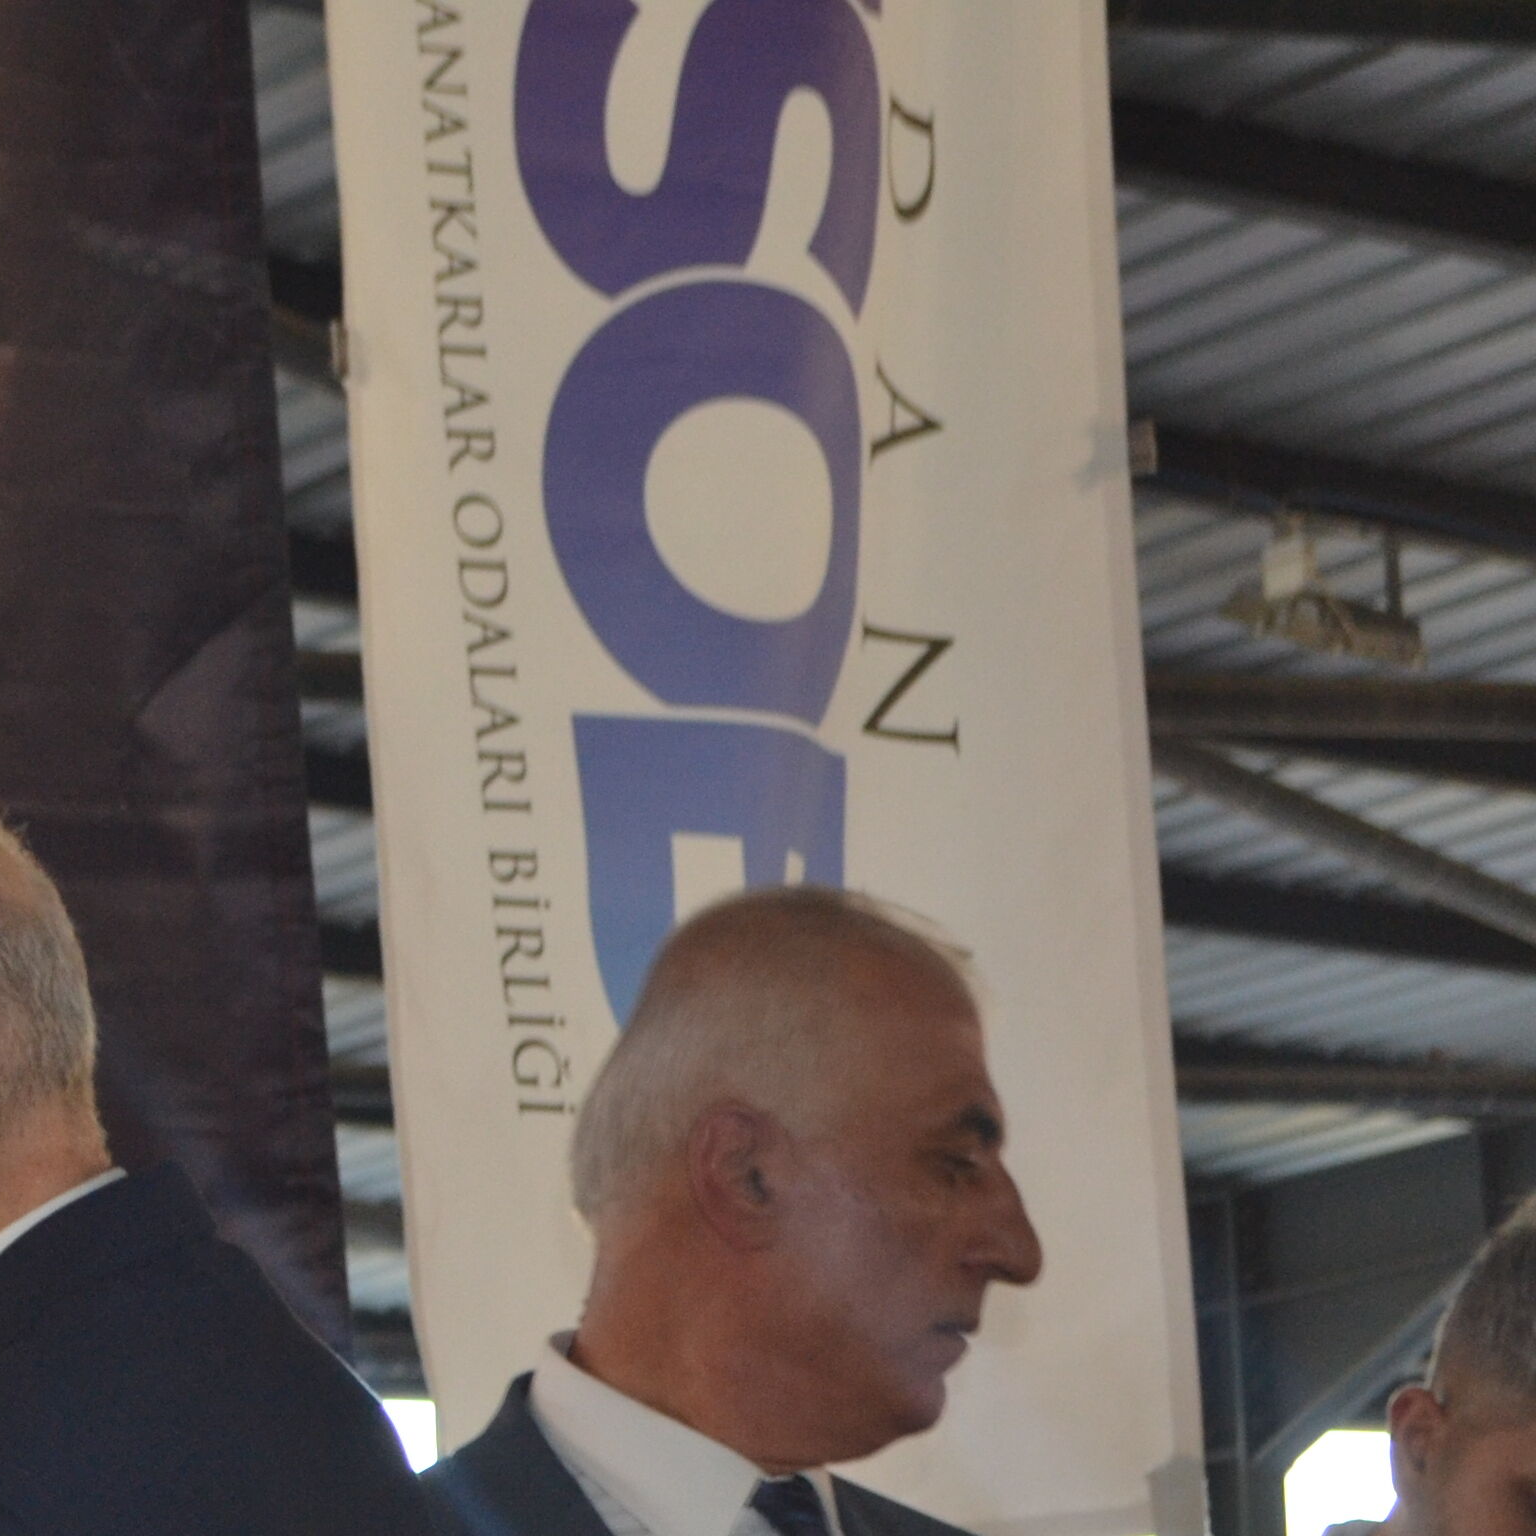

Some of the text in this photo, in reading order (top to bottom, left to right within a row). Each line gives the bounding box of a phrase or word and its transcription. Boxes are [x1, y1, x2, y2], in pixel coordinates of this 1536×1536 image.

[415, 0, 577, 1116] ANATKARLAR ODALARI BİRLİĞİ
